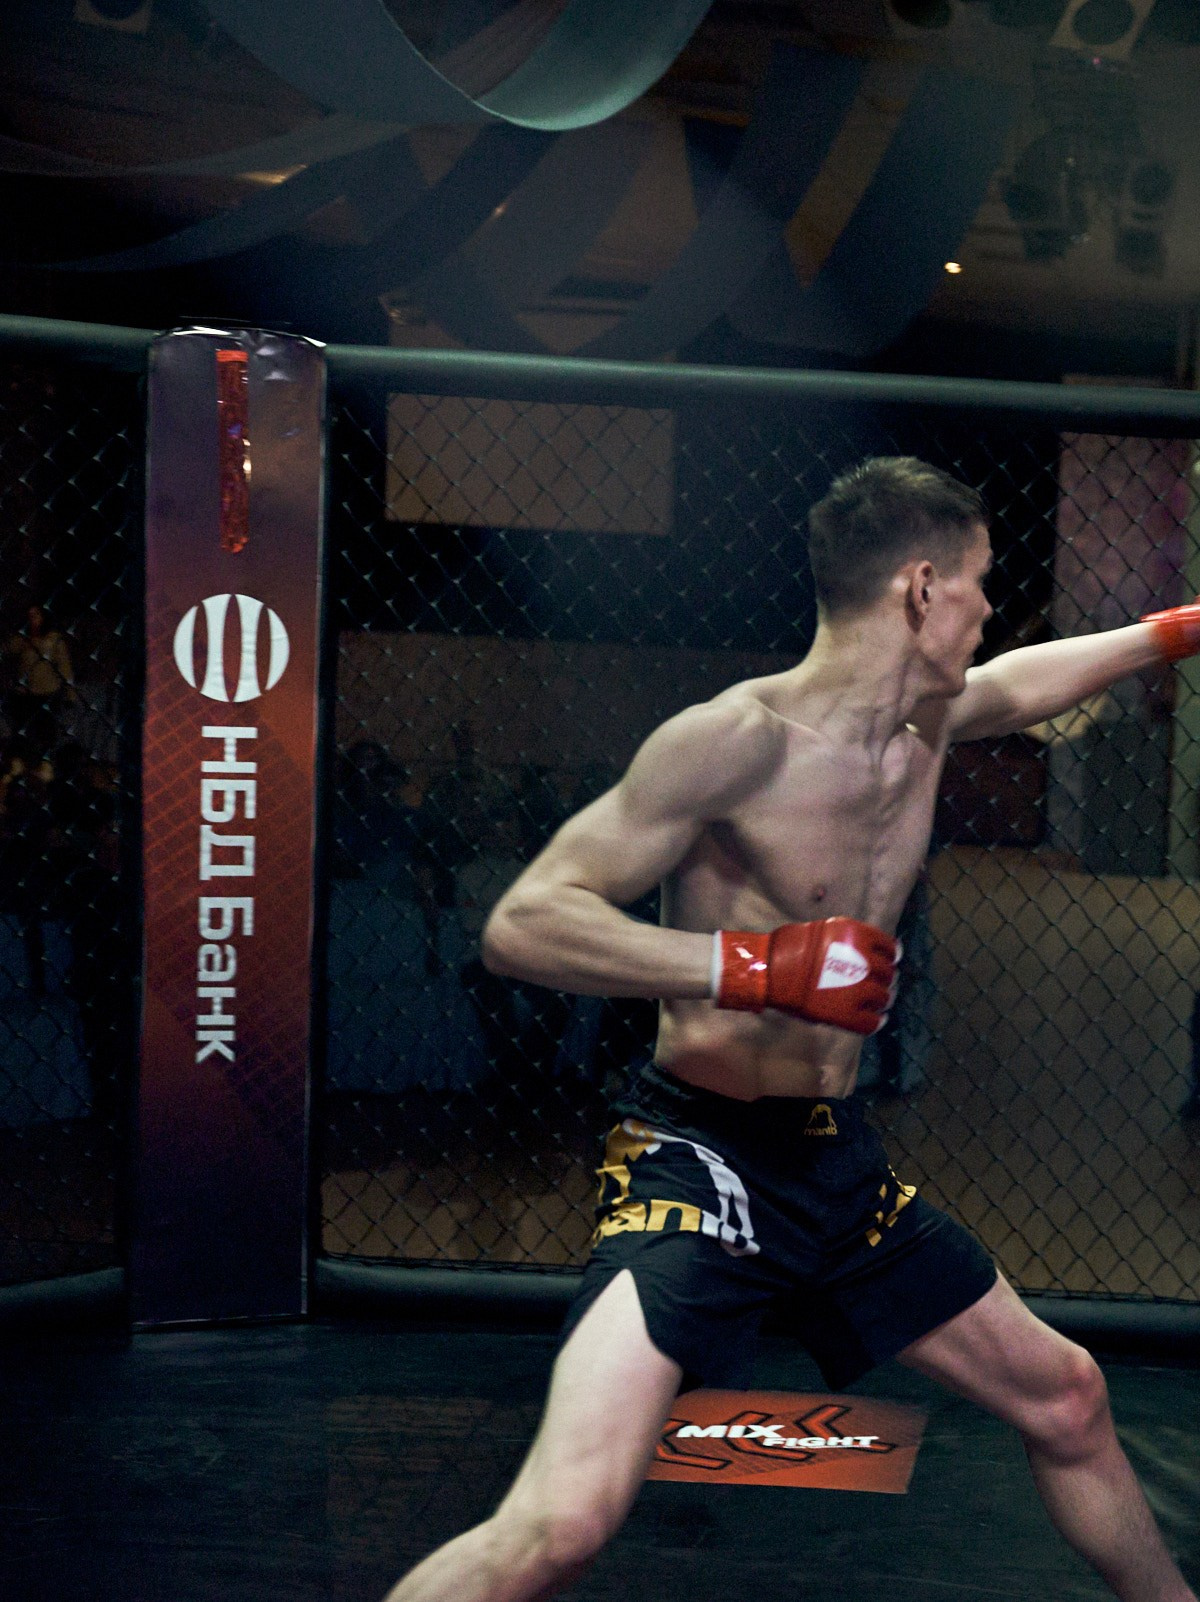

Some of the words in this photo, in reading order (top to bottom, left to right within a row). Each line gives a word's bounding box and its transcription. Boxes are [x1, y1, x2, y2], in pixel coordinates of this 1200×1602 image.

[200, 726, 258, 881] НБД
[195, 896, 254, 1063] Банк
[676, 1424, 785, 1439] MIX
[762, 1435, 880, 1449] FIGHT
